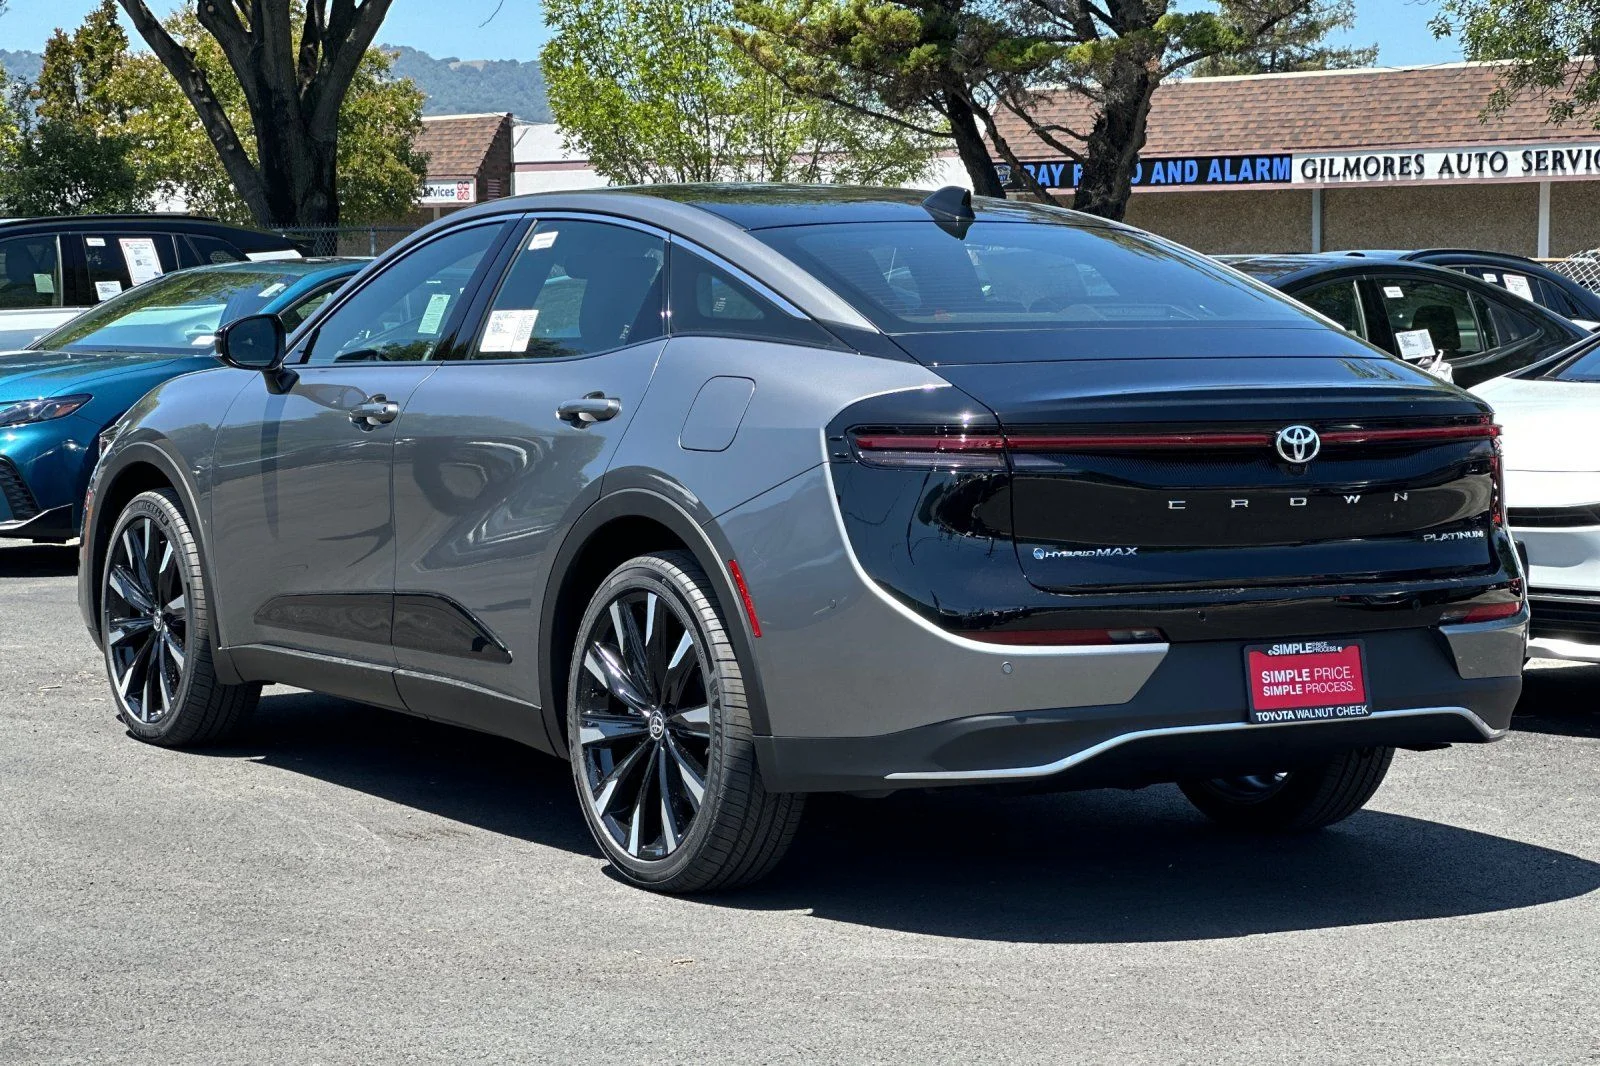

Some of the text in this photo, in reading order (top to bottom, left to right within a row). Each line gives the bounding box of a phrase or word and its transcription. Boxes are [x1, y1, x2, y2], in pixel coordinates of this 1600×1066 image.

[1150, 160, 1199, 184] AND
[1207, 157, 1291, 182] ALARM
[1300, 154, 1425, 179] GILMORES
[1438, 151, 1508, 174] AUTO
[422, 185, 455, 197] ervices
[1168, 492, 1408, 509] CROWN
[1423, 530, 1484, 542] PLATINUM
[1272, 643, 1313, 656] SIMPLE
[1261, 666, 1355, 684] SIMPLE PRICE.
[1263, 681, 1356, 697] SIMPLE PROCESS.
[1256, 710, 1295, 722] TOYOTA
[1296, 707, 1334, 719] WALNUT
